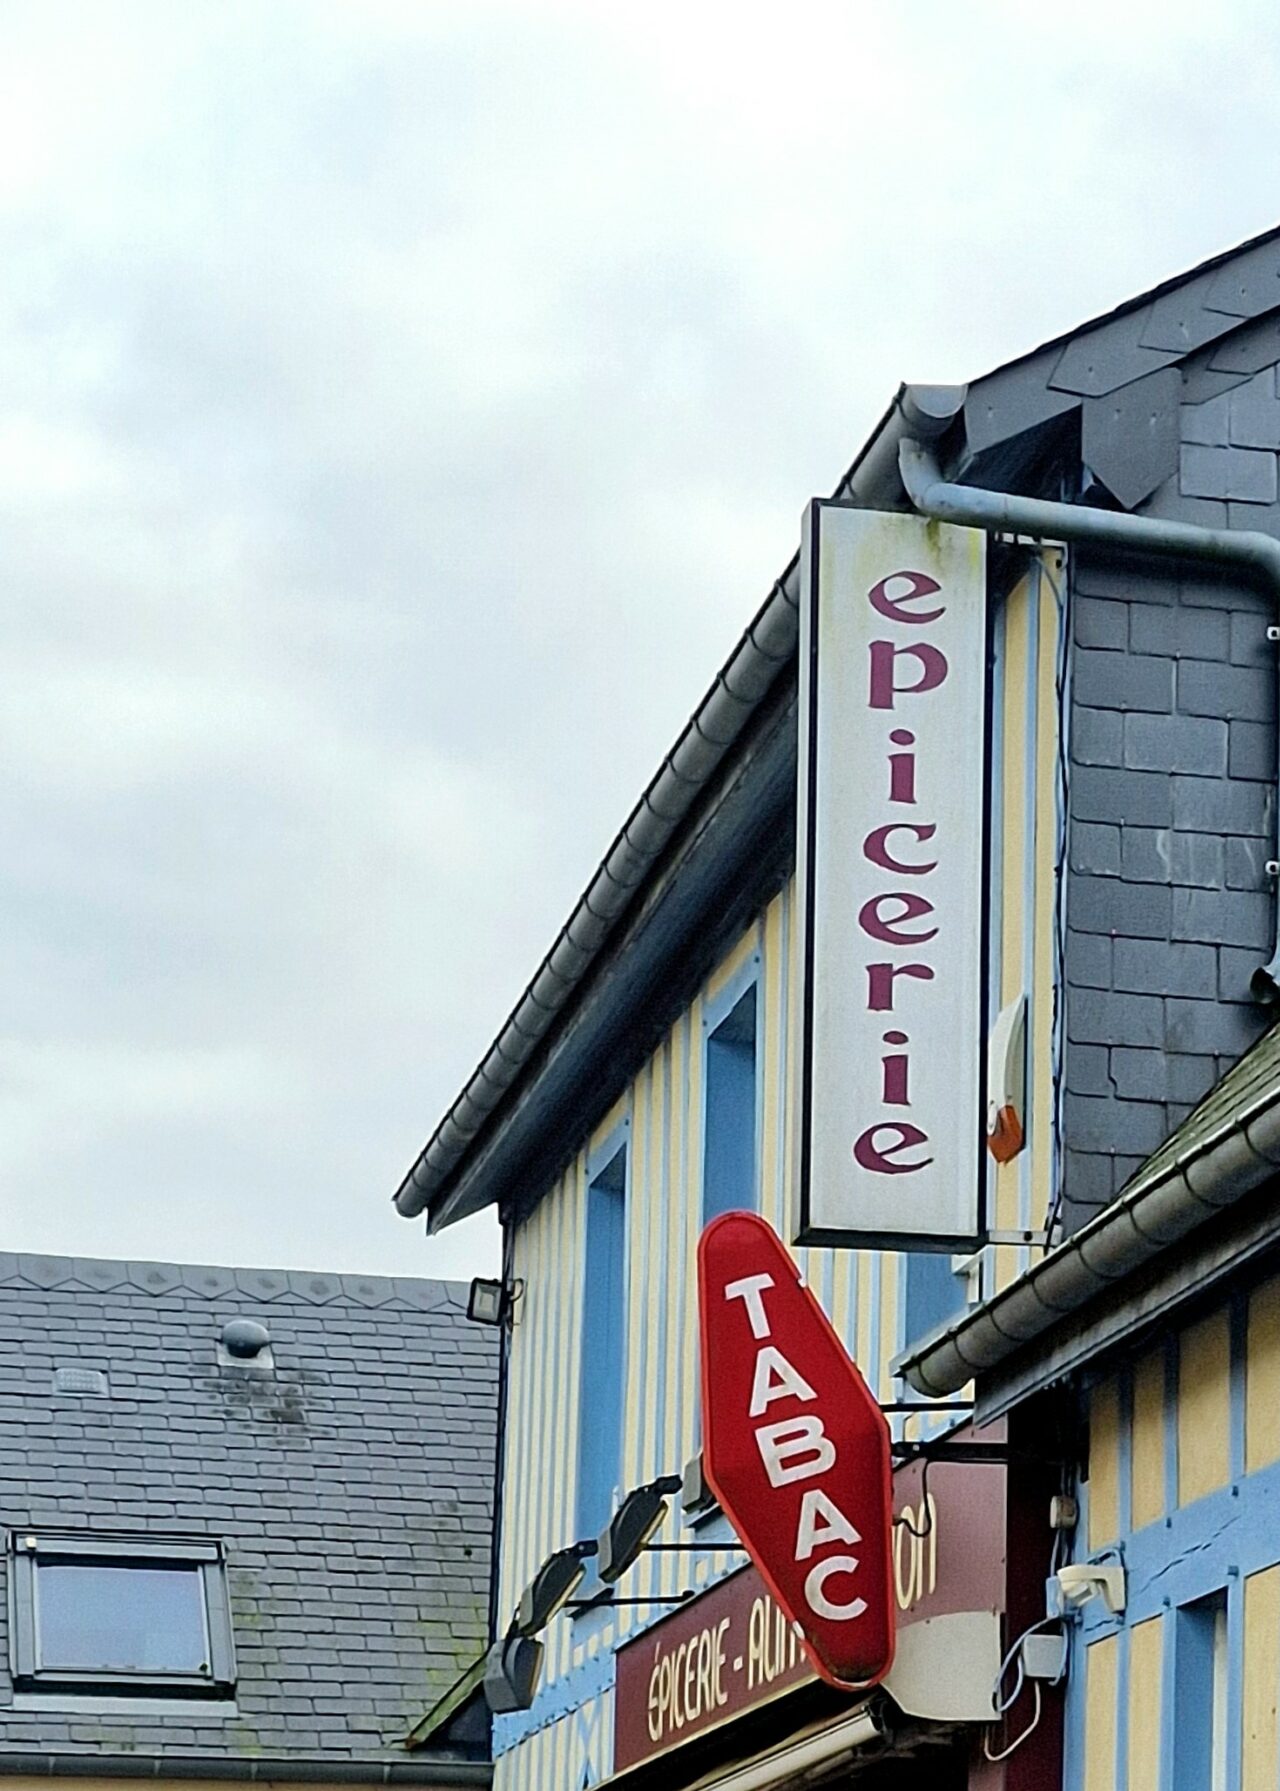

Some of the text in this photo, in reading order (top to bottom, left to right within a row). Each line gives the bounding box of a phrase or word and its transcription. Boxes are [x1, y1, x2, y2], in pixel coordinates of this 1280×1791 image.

[853, 570, 949, 1175] epicerie
[724, 1272, 869, 1621] TABAC
[648, 1617, 731, 1742] ÉPICERIE
